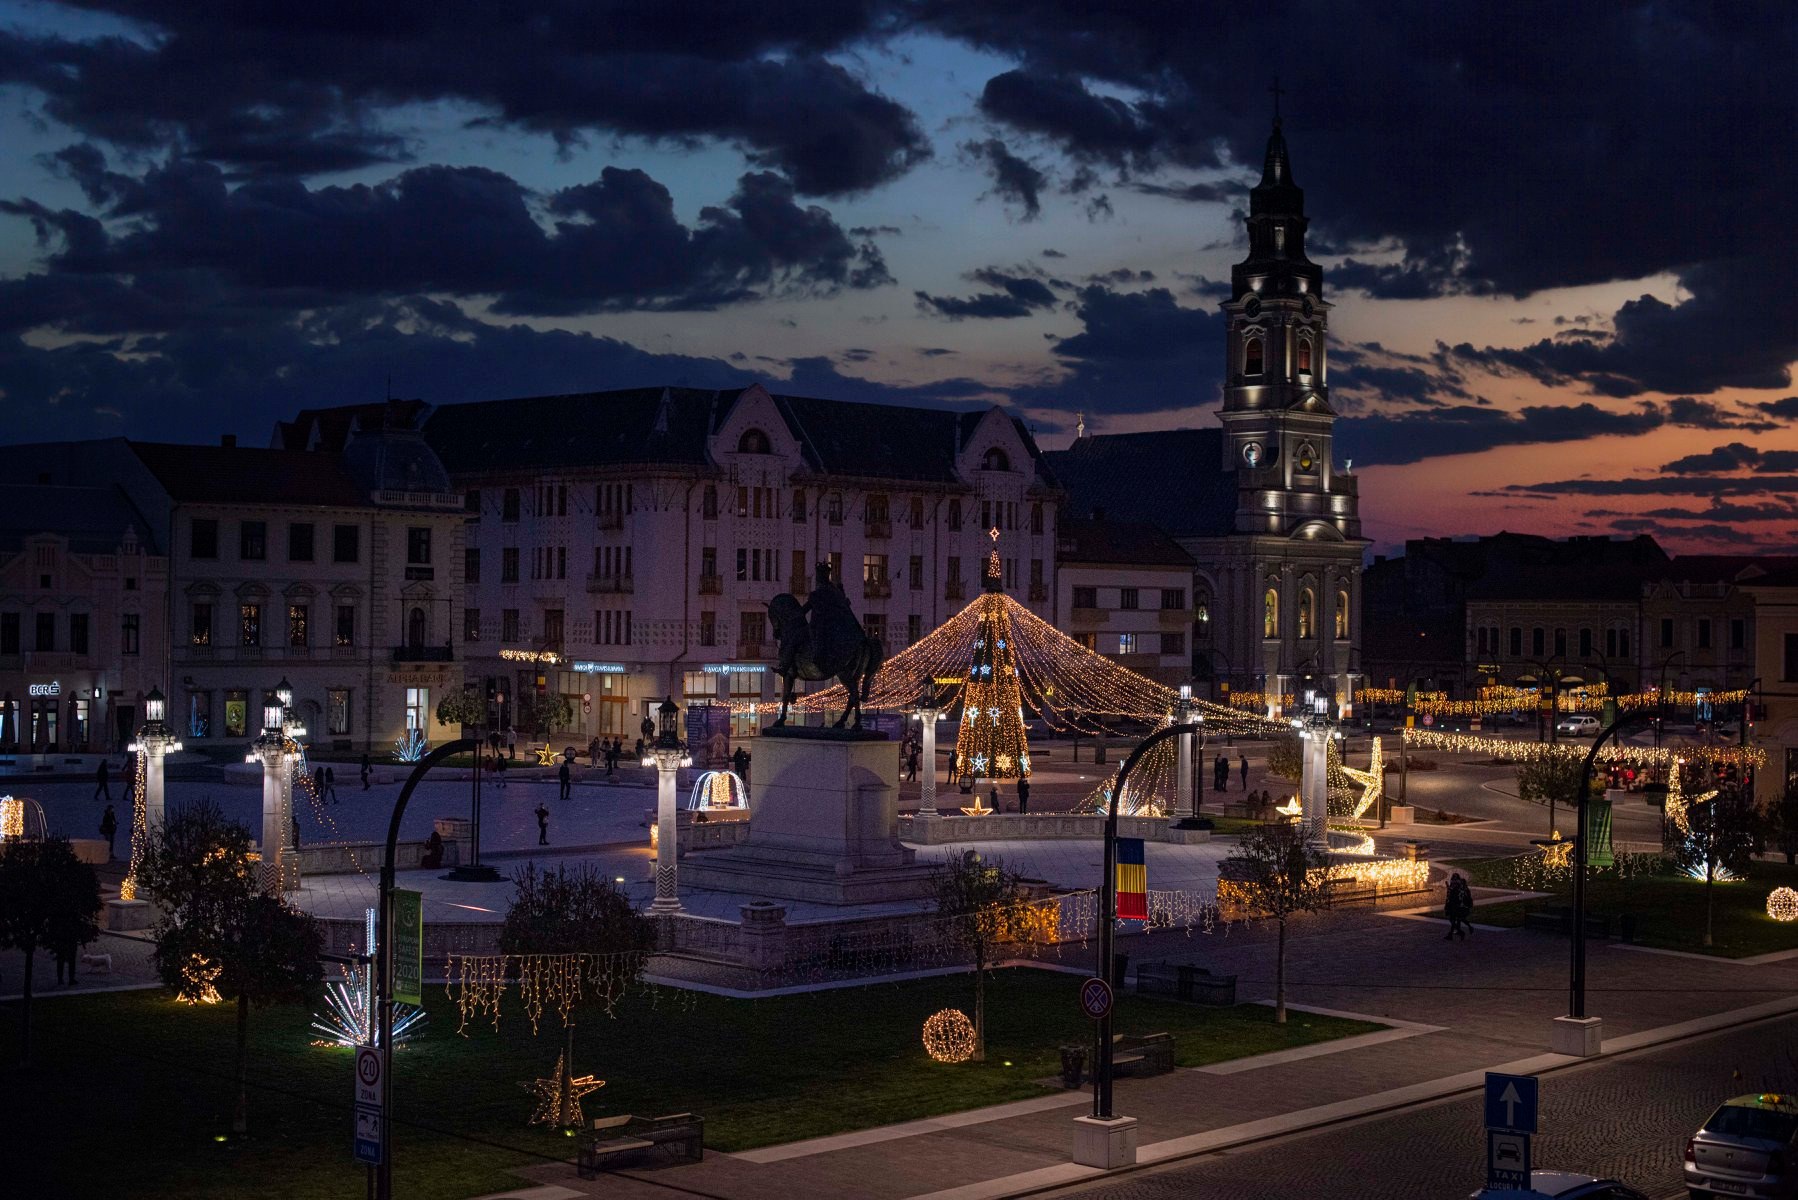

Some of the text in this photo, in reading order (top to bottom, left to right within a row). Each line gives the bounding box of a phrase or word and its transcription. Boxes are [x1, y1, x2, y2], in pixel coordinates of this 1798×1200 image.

[30, 685, 49, 695] BCR
[397, 964, 419, 979] 2020
[362, 1060, 375, 1077] 20
[361, 1089, 376, 1101] ZONA
[360, 1144, 376, 1158] ZONA
[1494, 1171, 1524, 1182] TAXI
[1490, 1182, 1514, 1191] LOCURI
